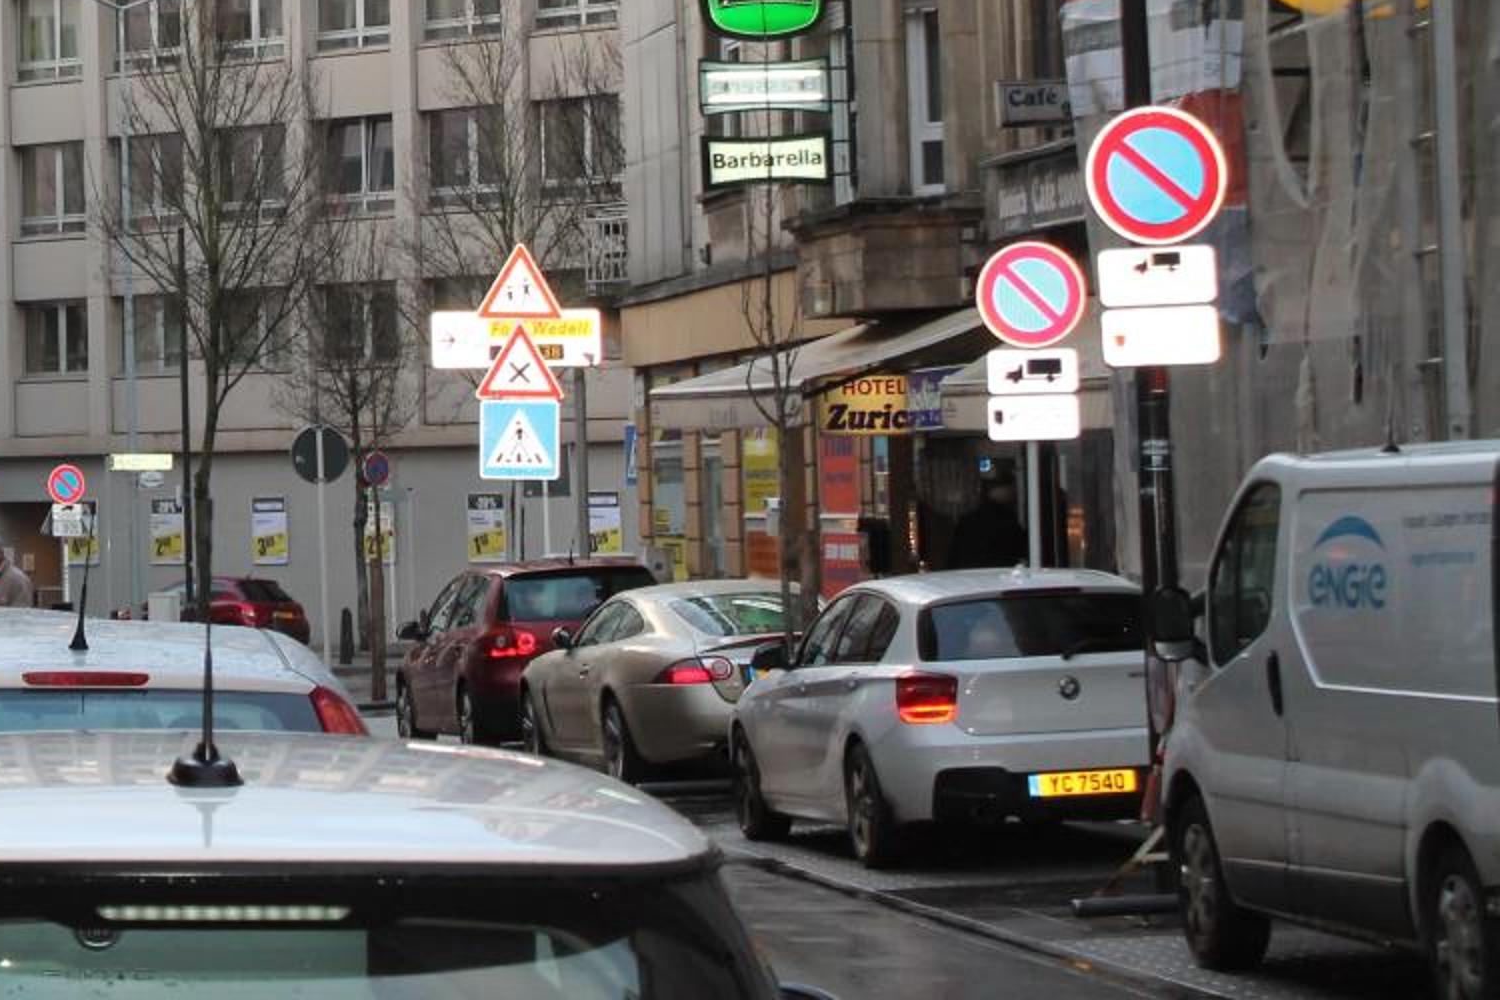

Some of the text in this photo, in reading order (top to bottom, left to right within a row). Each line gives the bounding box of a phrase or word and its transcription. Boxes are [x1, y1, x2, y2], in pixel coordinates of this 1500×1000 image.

[1008, 87, 1057, 107] Café
[712, 150, 822, 170] Barbarella
[842, 378, 906, 396] HOTEL
